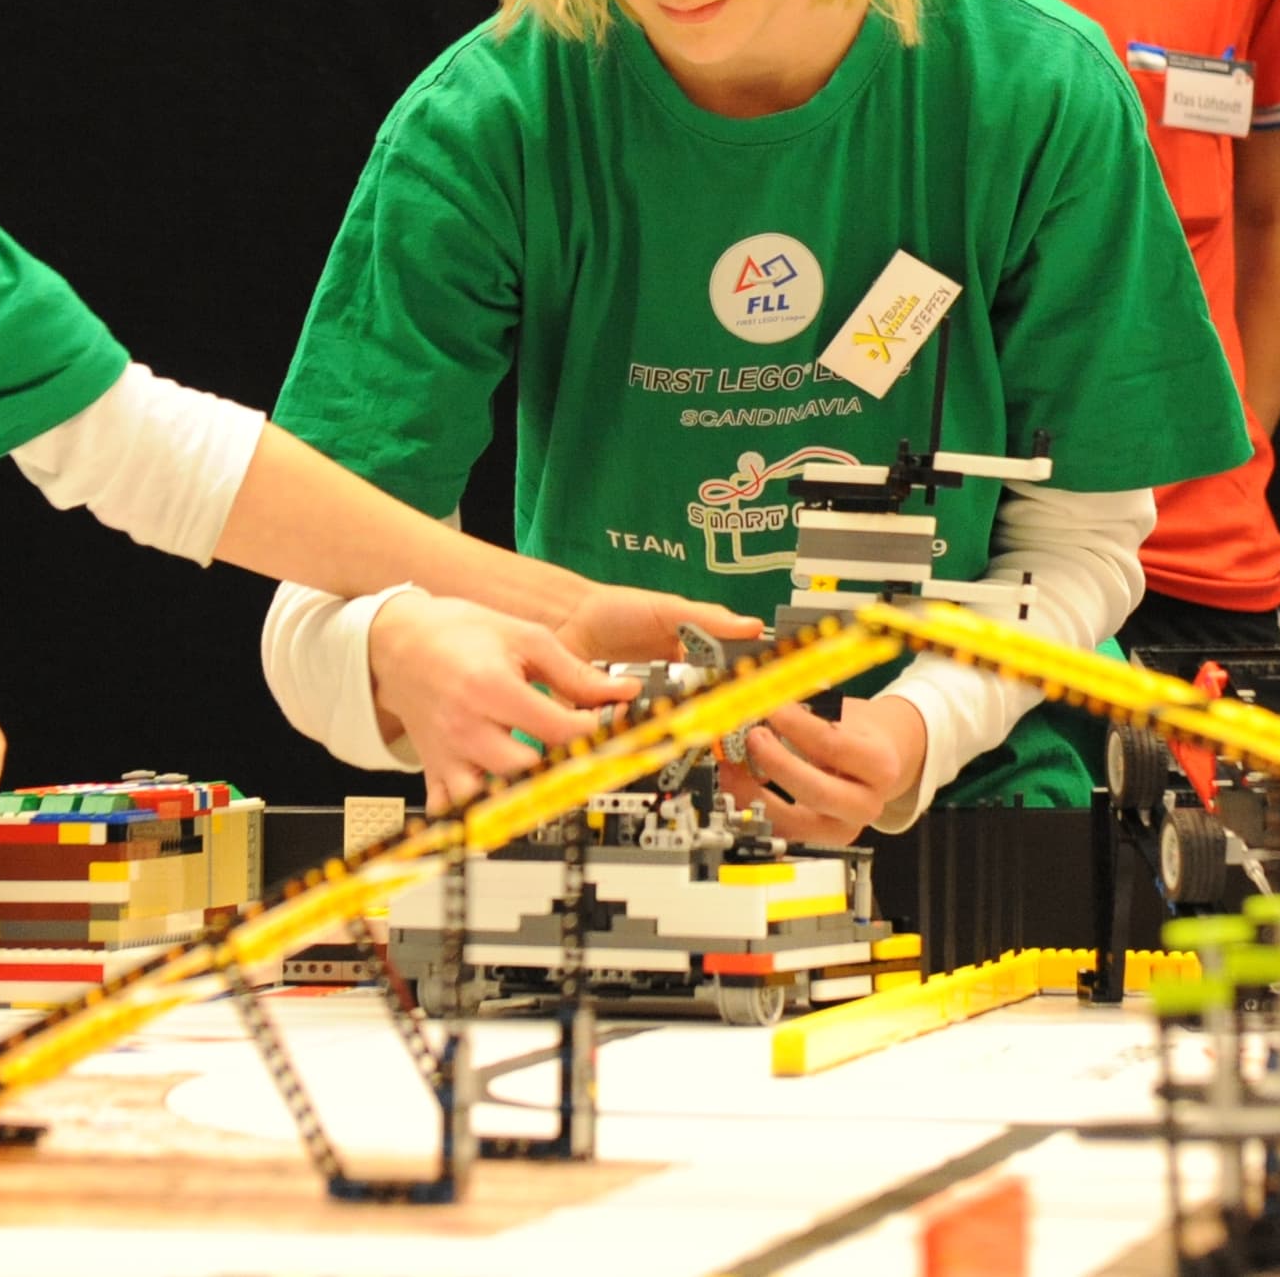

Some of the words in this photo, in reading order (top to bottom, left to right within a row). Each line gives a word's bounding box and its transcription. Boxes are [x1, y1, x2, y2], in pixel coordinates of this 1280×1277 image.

[746, 294, 790, 315] FLL
[628, 363, 712, 392] FIRST
[680, 397, 862, 427] SCANDINAVIA
[687, 503, 788, 532] SMART
[606, 530, 687, 561] TEAM
